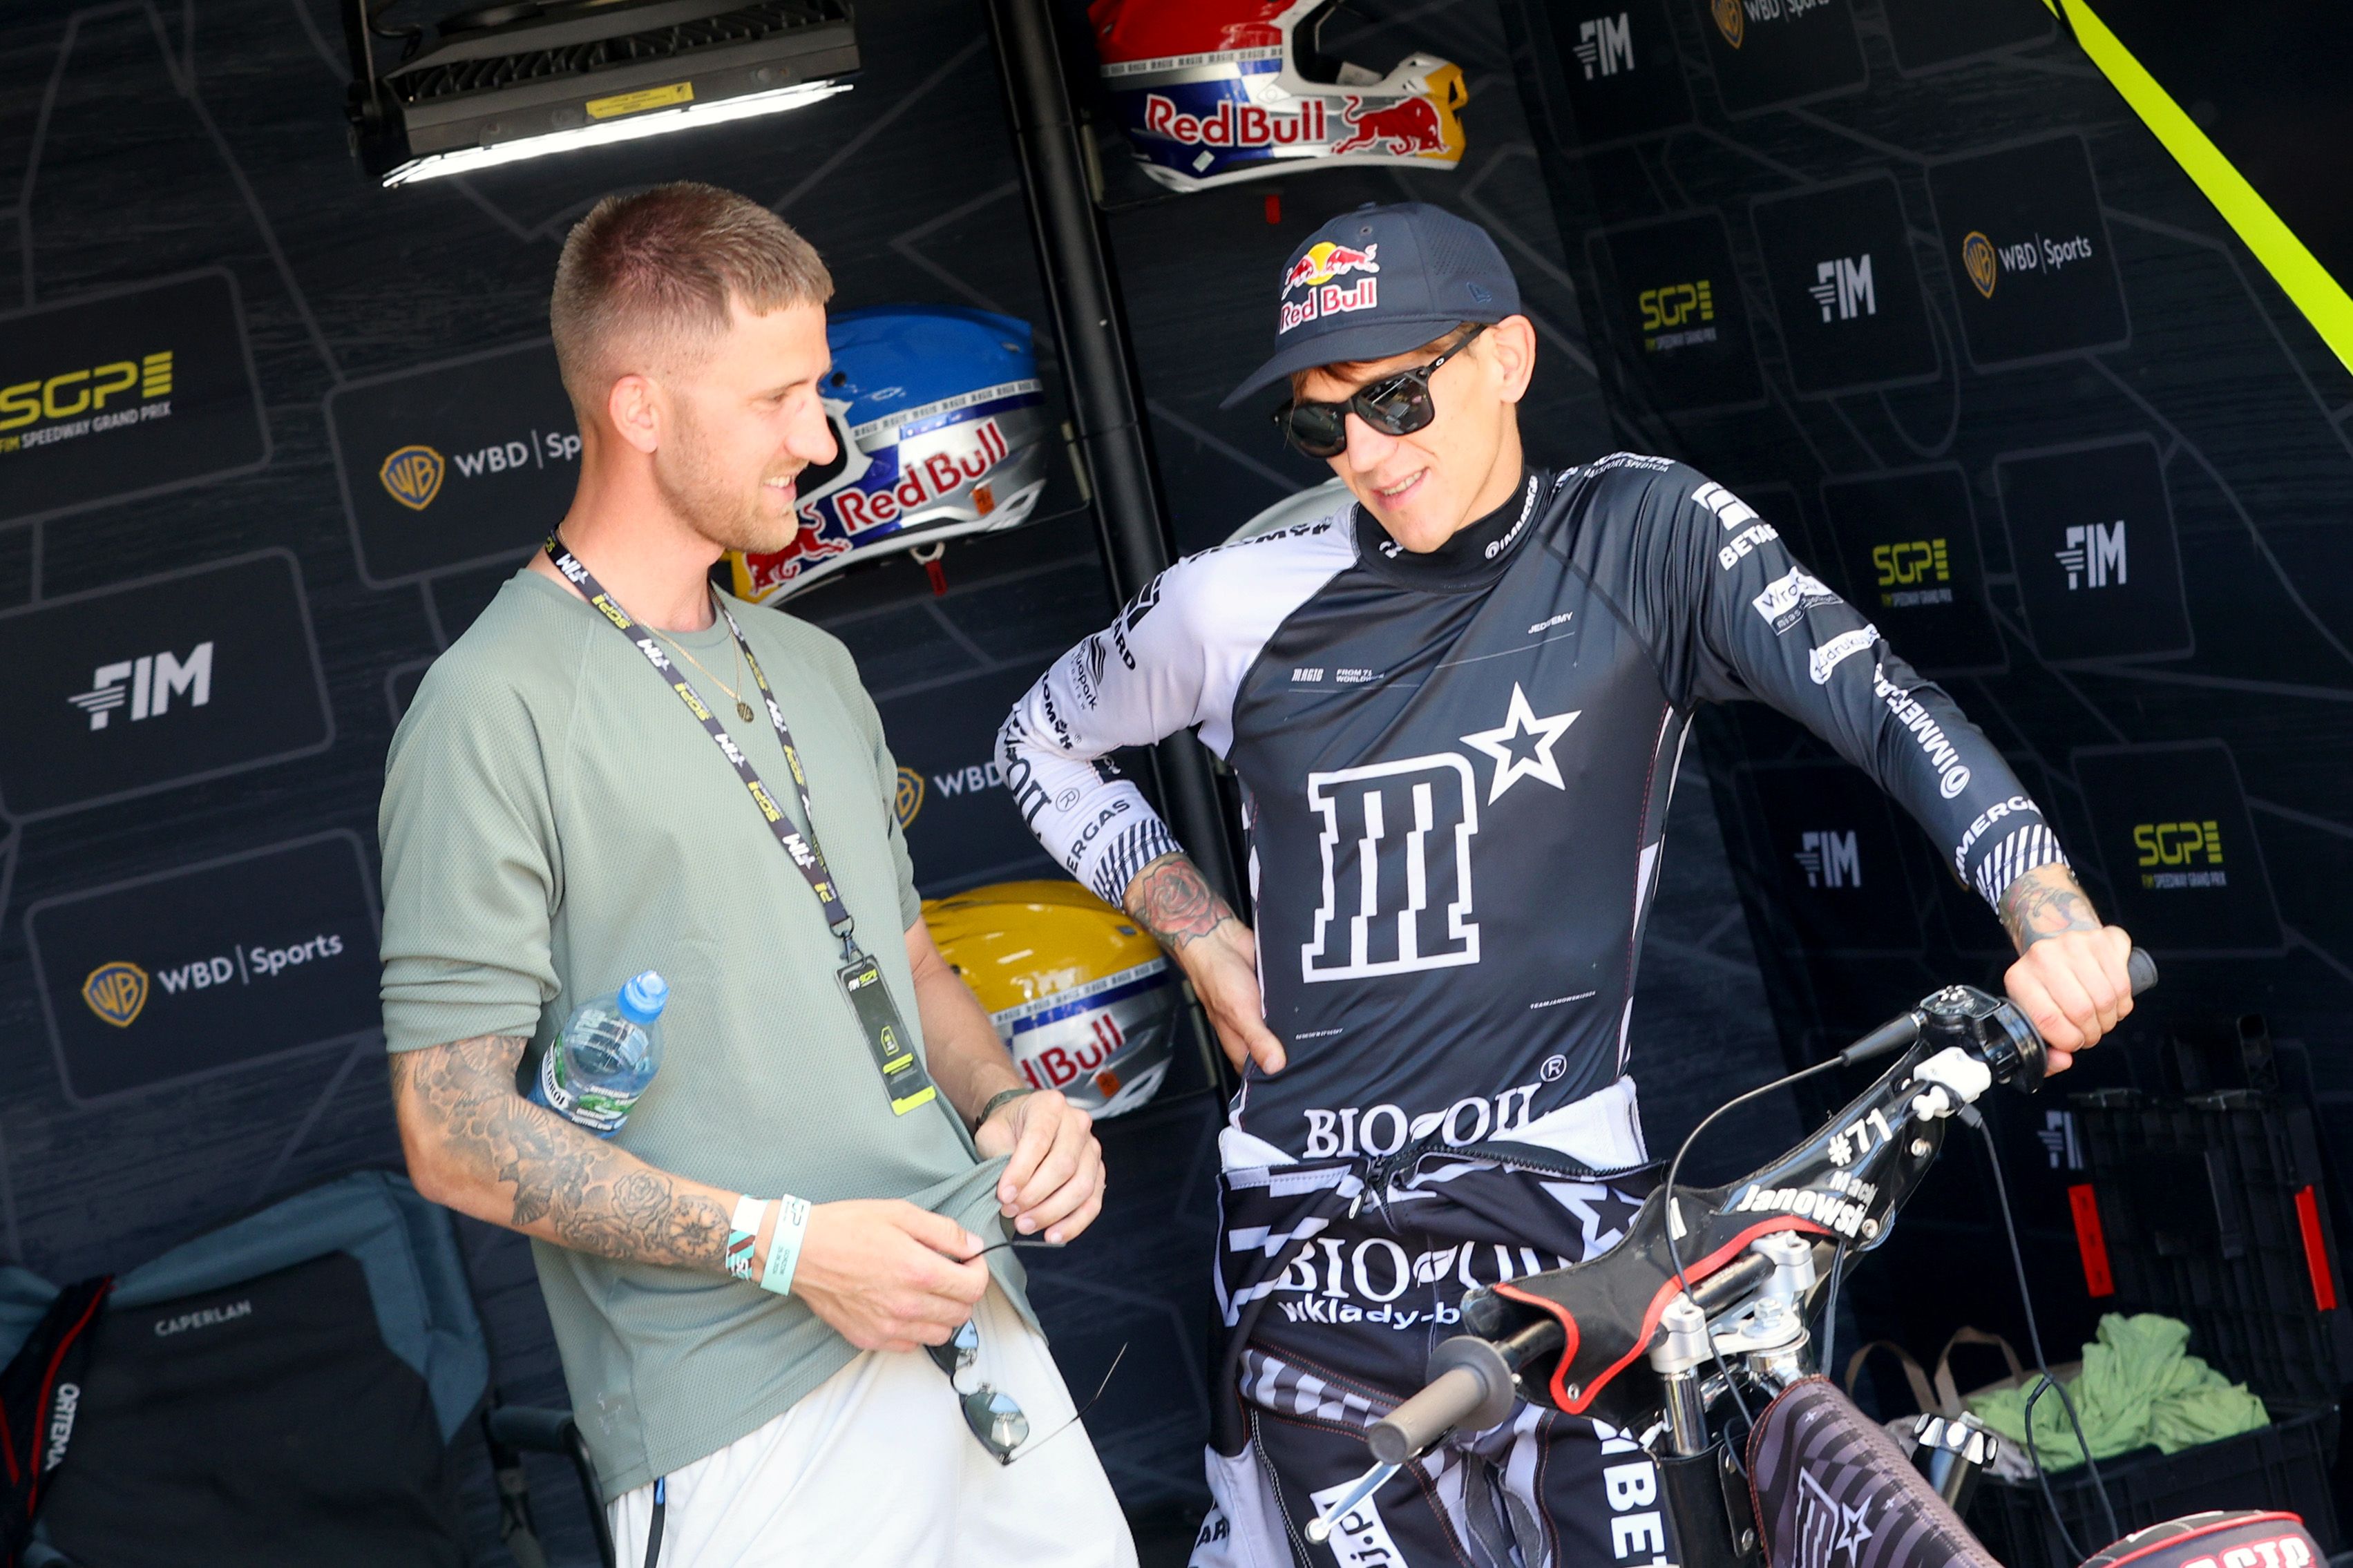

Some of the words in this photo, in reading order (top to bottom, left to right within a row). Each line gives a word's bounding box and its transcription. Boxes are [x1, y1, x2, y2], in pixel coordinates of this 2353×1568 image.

[1572, 12, 1635, 81] FIM
[1145, 93, 1230, 146] Red
[1239, 97, 1324, 146] Bull
[1999, 242, 2037, 272] WBD
[2044, 236, 2093, 270] Sports
[1280, 289, 1315, 333] Red
[1322, 278, 1375, 315] Bull
[1809, 254, 1876, 323] FIM
[92, 408, 139, 432] GRAND
[454, 441, 529, 478] WBD
[835, 465, 925, 535] Red
[926, 421, 1009, 495] Bull
[2055, 520, 2127, 591] FIM
[67, 642, 214, 731] FIM
[1336, 668, 1362, 676] FROM
[933, 760, 1003, 799] WBD
[1793, 829, 1862, 889] FIM
[157, 956, 234, 995] WBD
[249, 934, 344, 977] Sports
[1038, 1013, 1124, 1087] Bull
[1827, 1107, 1893, 1167] #71
[2037, 1109, 2084, 1169] FI
[154, 1299, 252, 1337] CAPERLAN
[44, 1381, 81, 1472] ORTEMA
